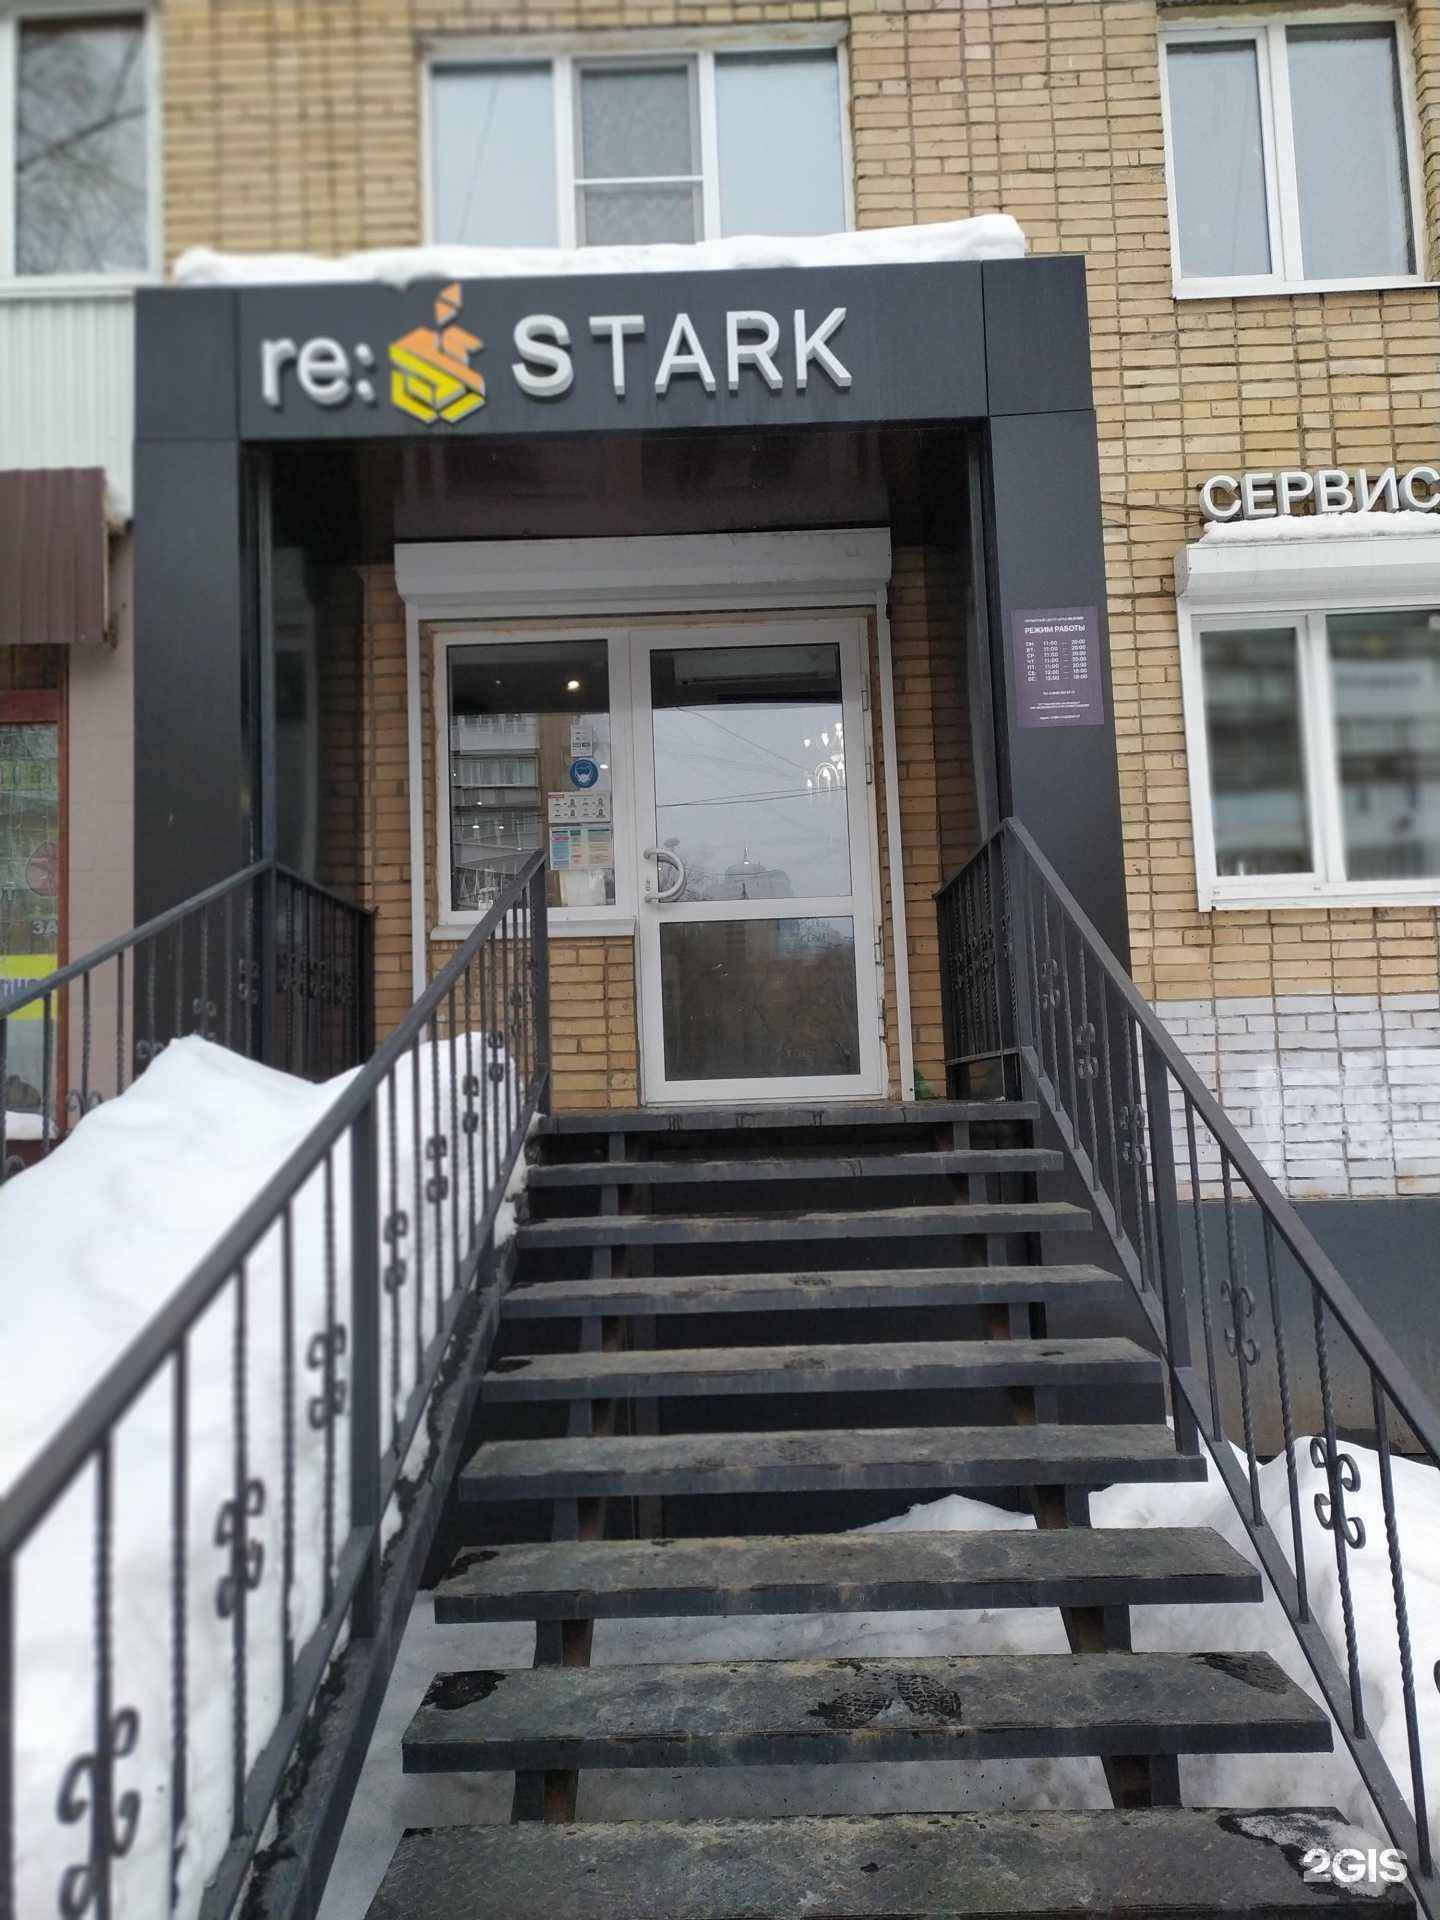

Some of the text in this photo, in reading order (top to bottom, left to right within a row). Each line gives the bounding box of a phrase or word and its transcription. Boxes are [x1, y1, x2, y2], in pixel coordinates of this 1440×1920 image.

[261, 307, 852, 405] re: STARK
[1200, 466, 1440, 521] СЕРВИС
[1024, 624, 1086, 634] РЕЖИМ РАБОТЫ
